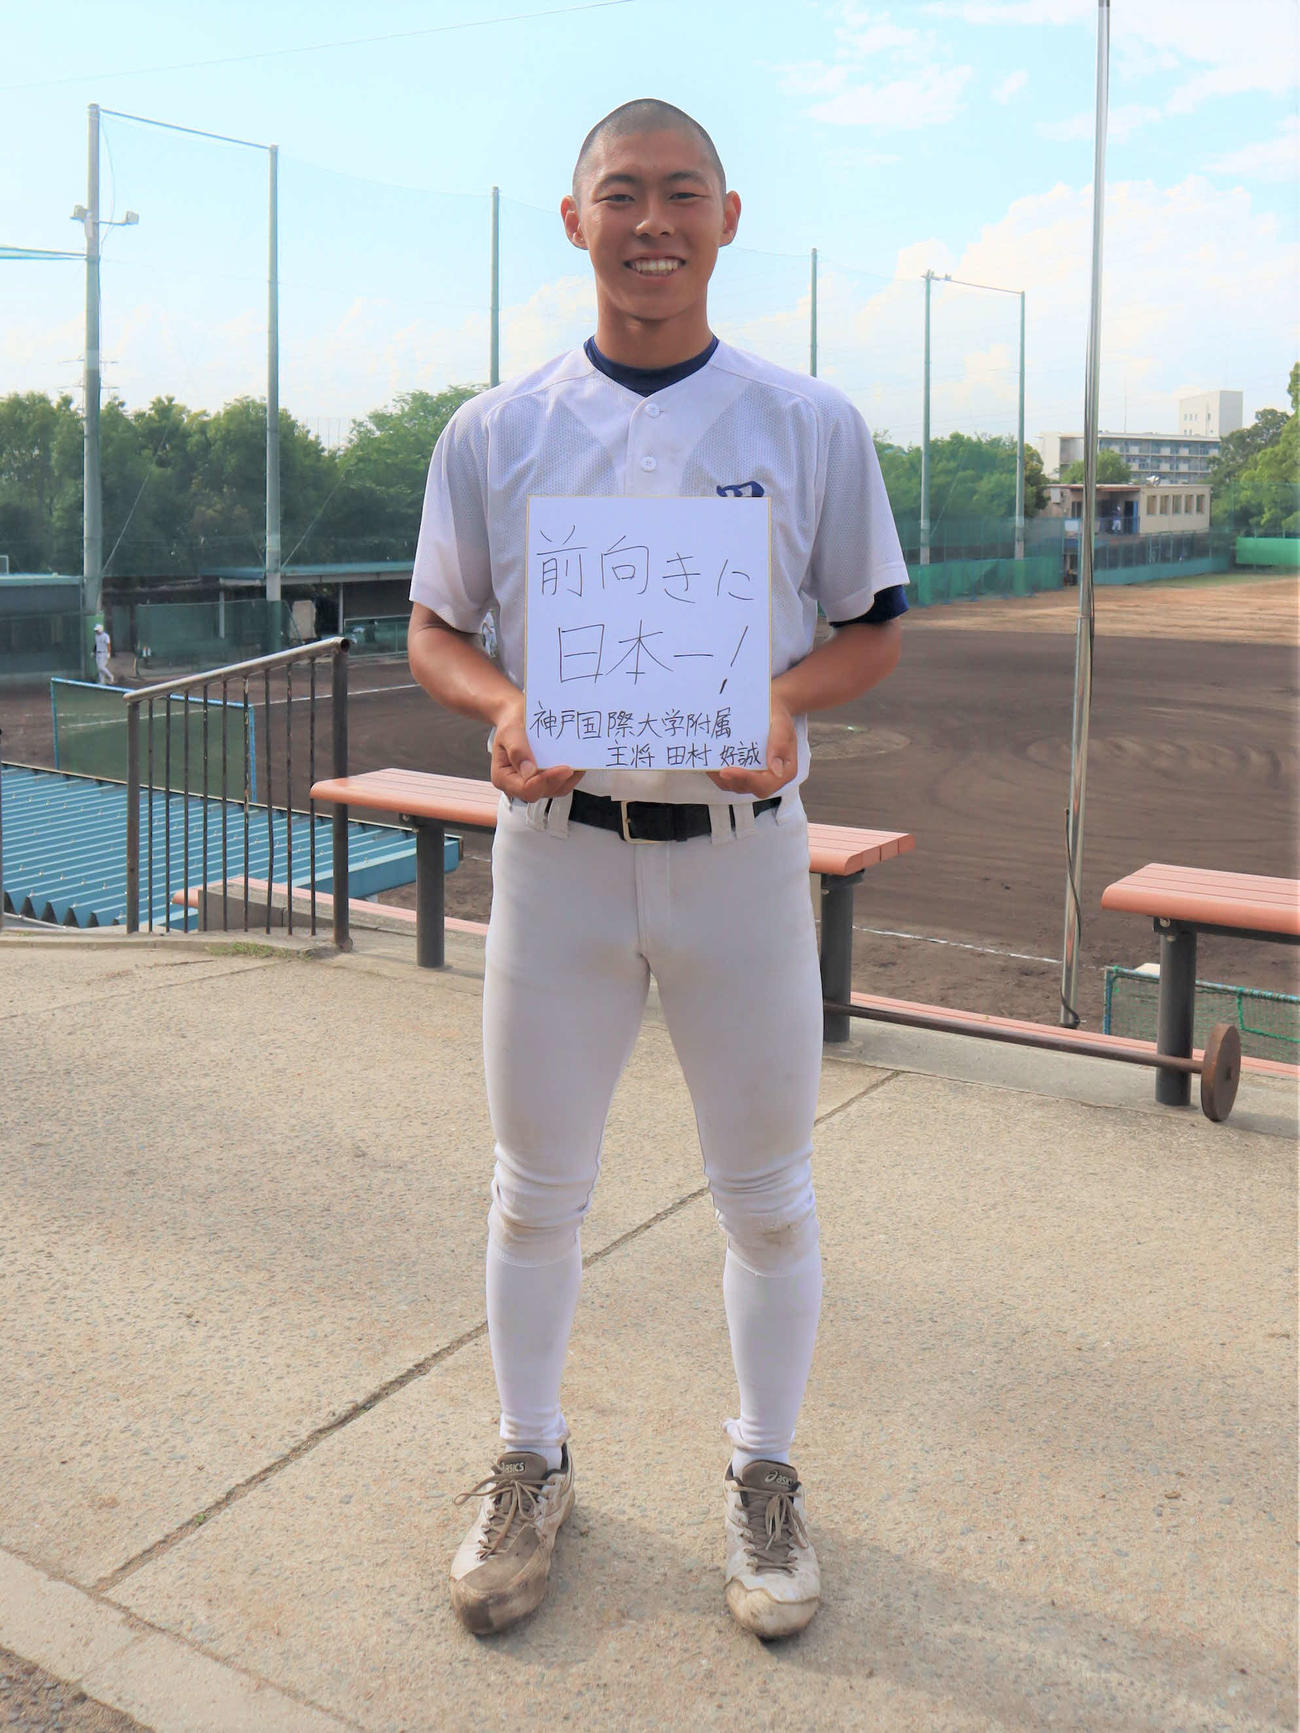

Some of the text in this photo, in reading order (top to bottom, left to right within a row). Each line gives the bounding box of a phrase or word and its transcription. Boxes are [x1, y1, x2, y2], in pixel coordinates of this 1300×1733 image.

[536, 525, 754, 603] 前向きに
[530, 701, 731, 739] 神戸国際大学附属
